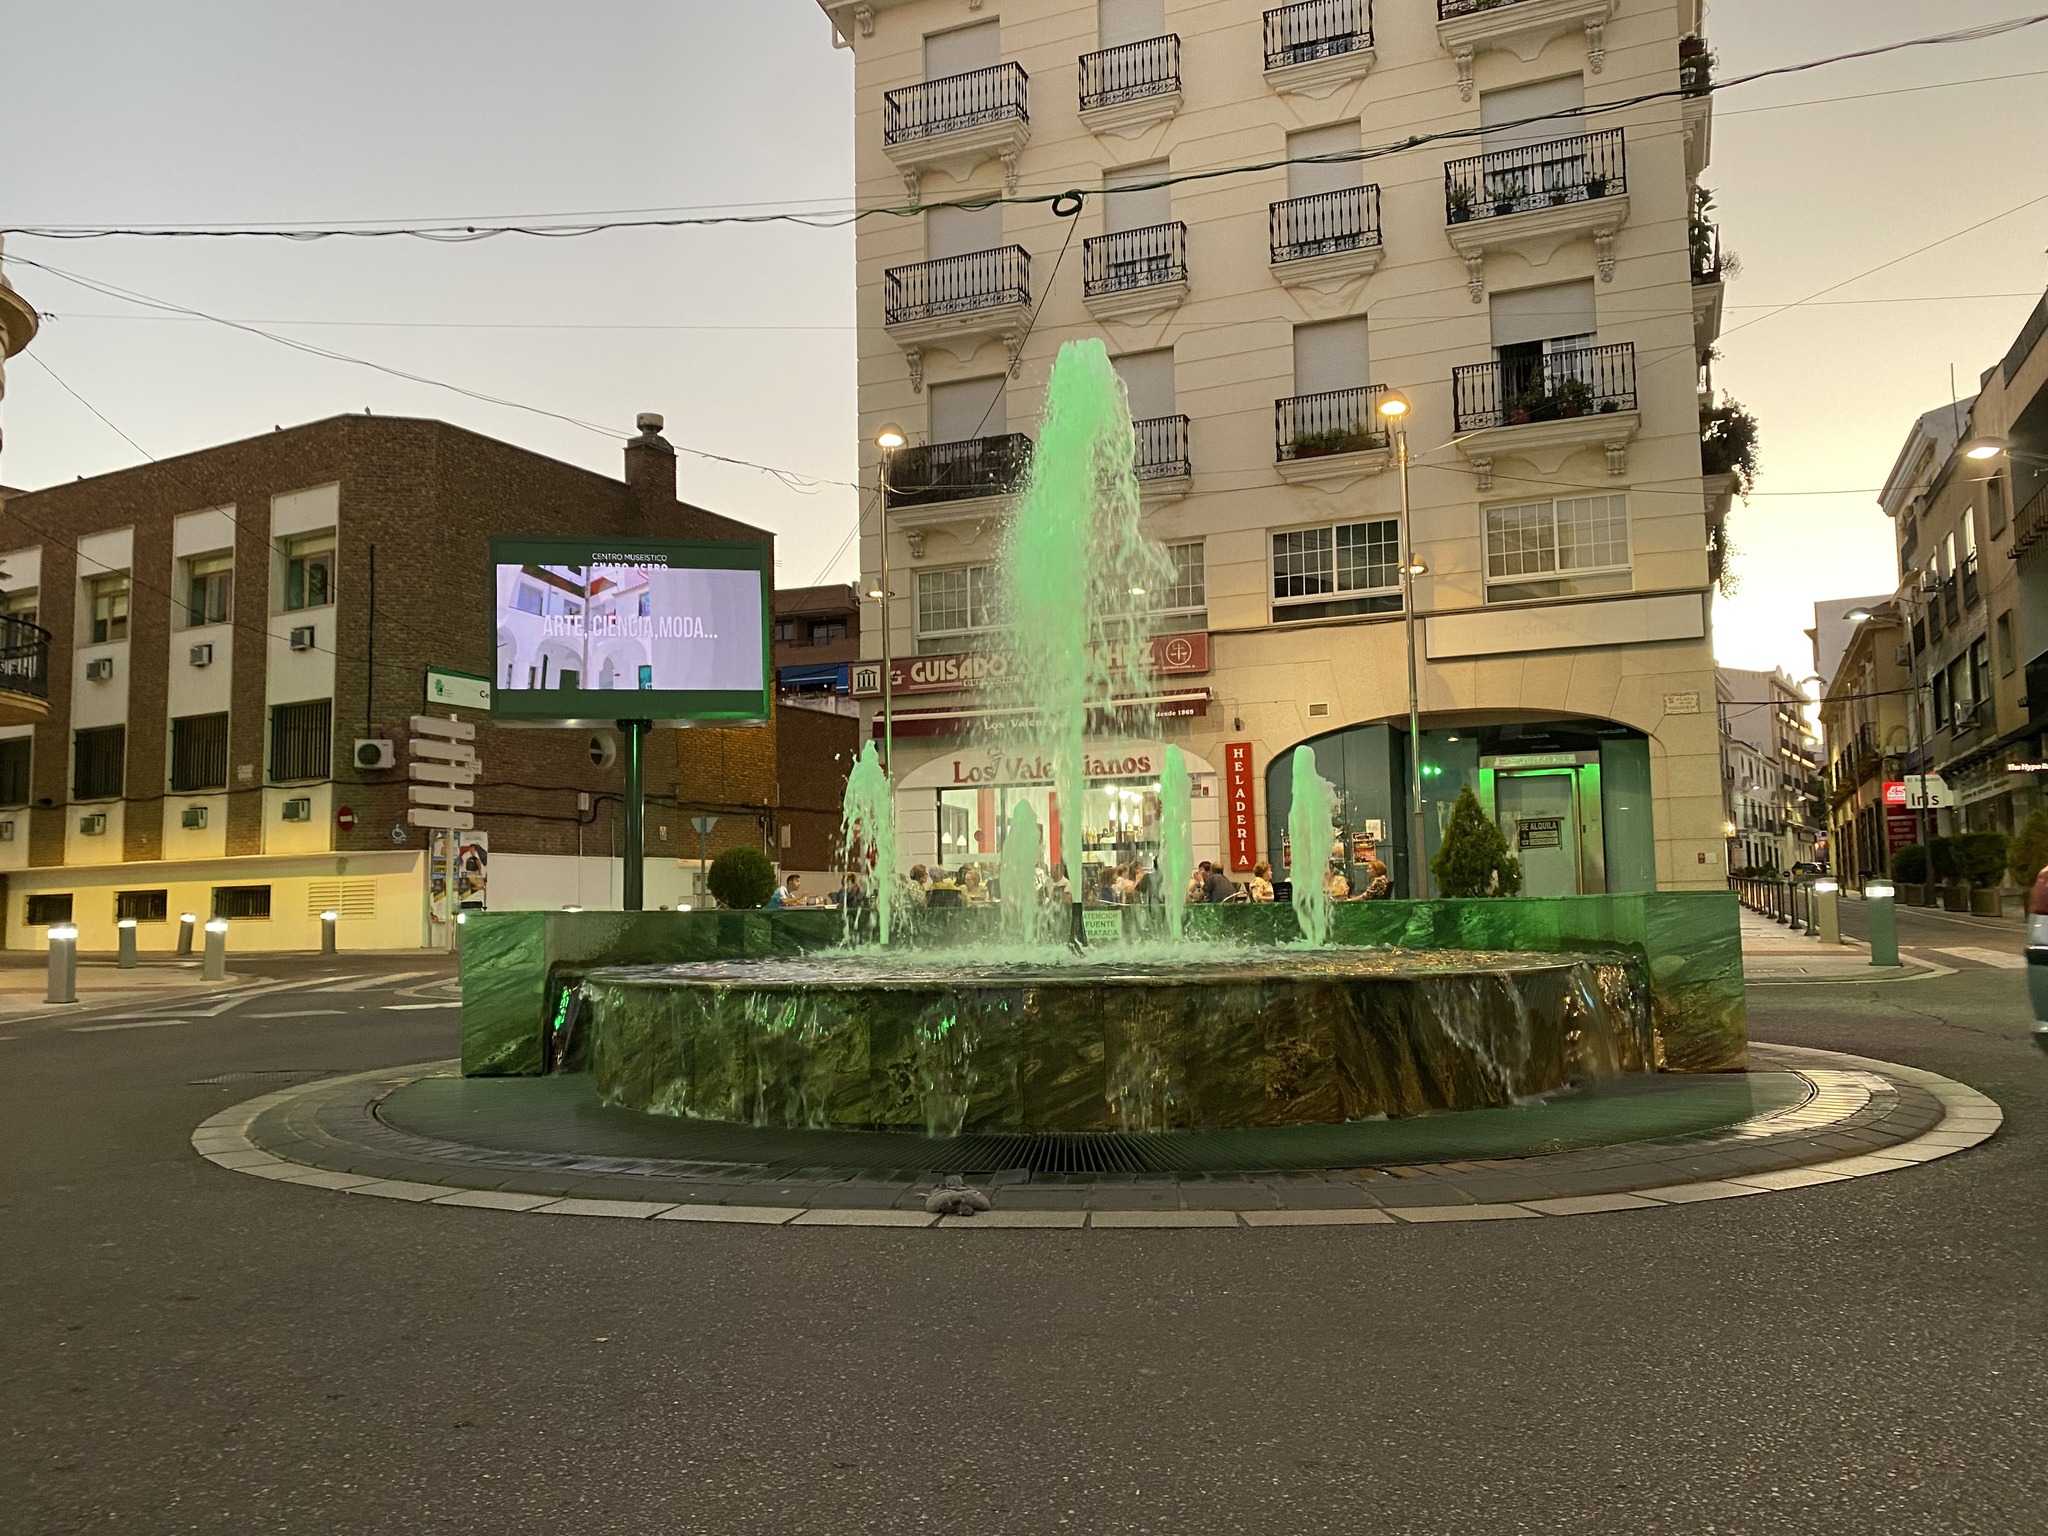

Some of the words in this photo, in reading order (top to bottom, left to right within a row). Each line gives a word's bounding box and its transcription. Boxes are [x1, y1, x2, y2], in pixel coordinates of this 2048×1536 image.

[592, 552, 623, 561] CENTRO
[543, 615, 588, 640] ARTE,
[910, 657, 1008, 683] GUISADO
[953, 760, 994, 784] Los
[2007, 763, 2021, 771] The
[1233, 748, 1249, 865] HELADERÍA
[1520, 823, 1529, 831] SE
[1530, 821, 1558, 831] ALQUILA
[1085, 920, 1116, 928] FUENTE
[1085, 929, 1119, 937] RATADA
